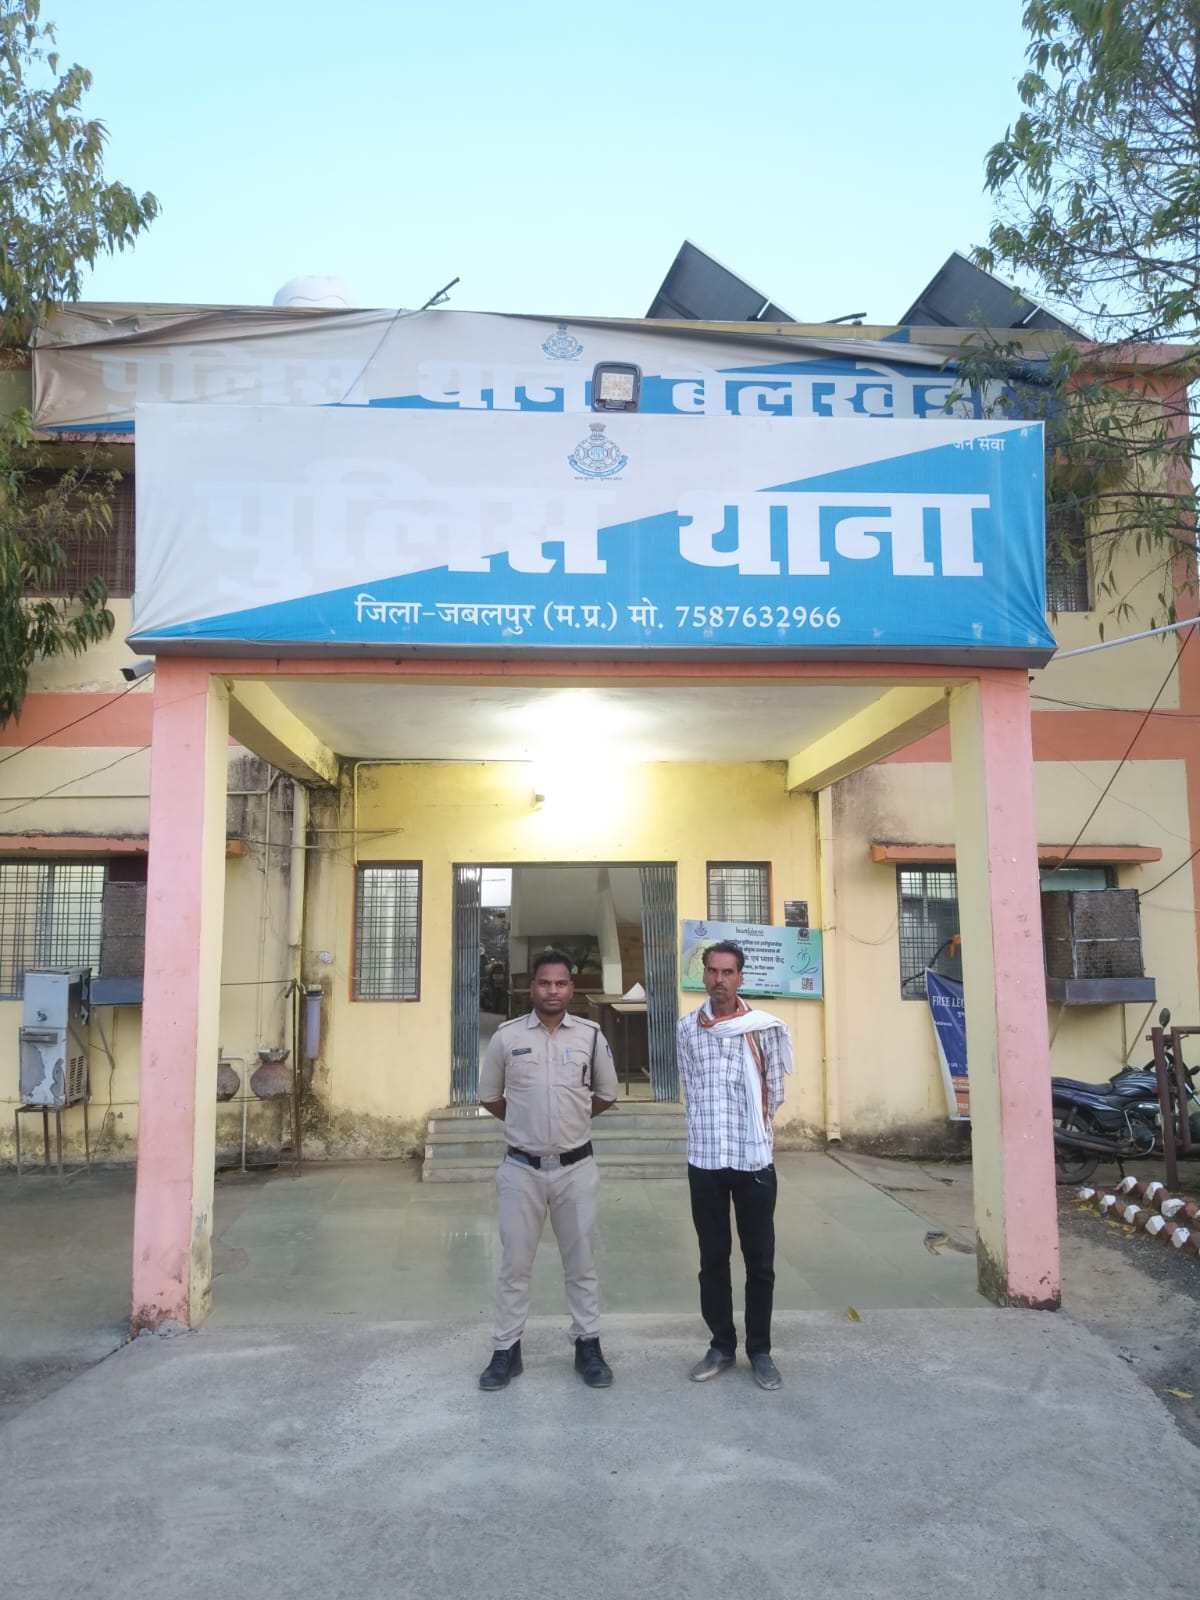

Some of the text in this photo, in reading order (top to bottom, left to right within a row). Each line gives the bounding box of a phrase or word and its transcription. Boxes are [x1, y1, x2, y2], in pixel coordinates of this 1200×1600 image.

[192, 456, 990, 599] पुलिस थाना
[354, 593, 841, 635] जिला-जबलपुर (म.प्र.) मो. 7587632966
[932, 995, 950, 1007] FREE
